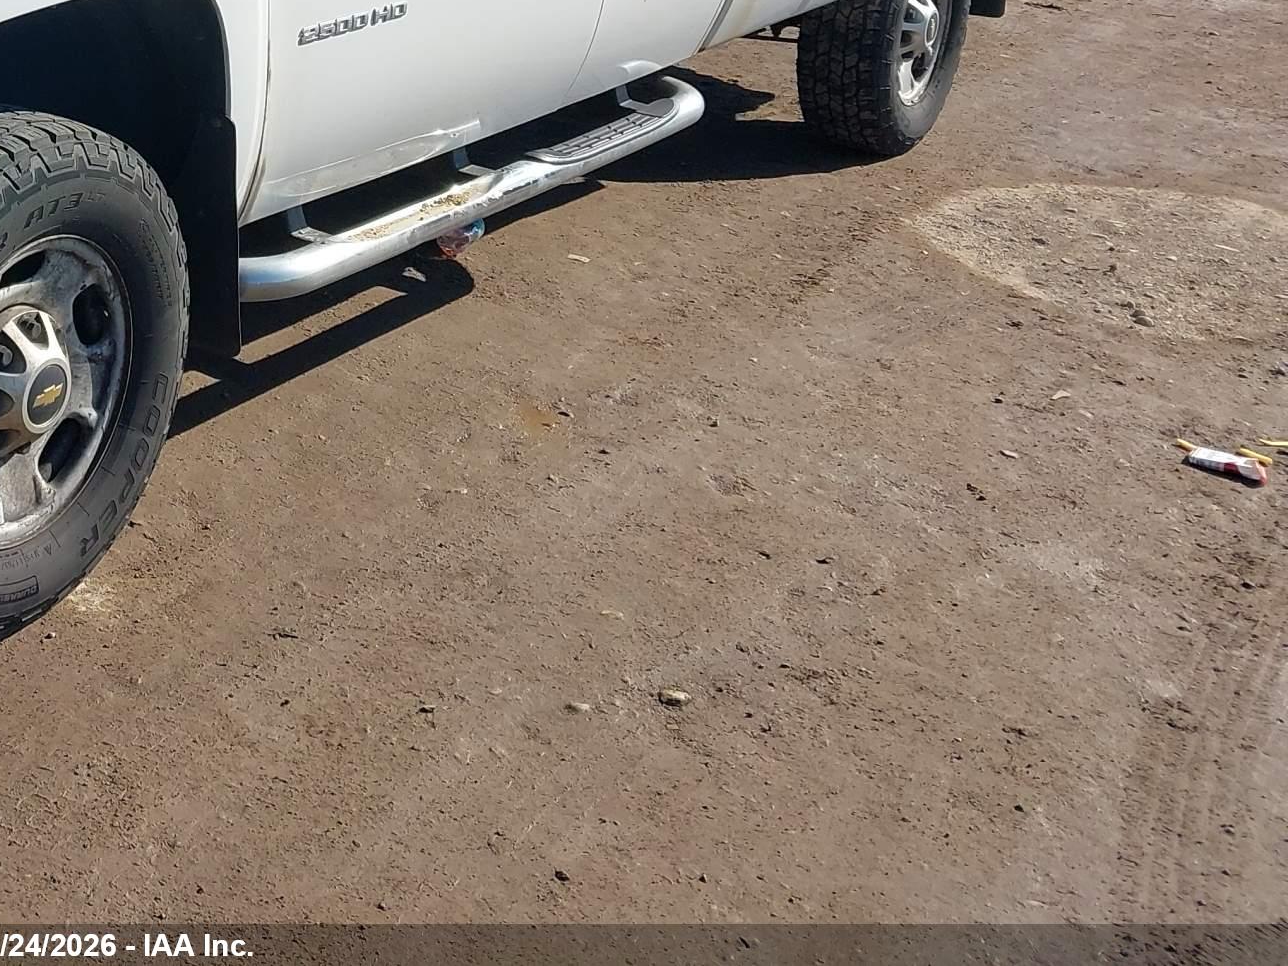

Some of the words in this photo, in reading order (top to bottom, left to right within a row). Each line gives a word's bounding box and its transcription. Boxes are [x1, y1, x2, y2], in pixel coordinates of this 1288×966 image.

[296, 14, 369, 47] 2500
[370, 2, 408, 27] HD
[23, 192, 84, 229] AT3
[80, 371, 169, 557] COOPER
